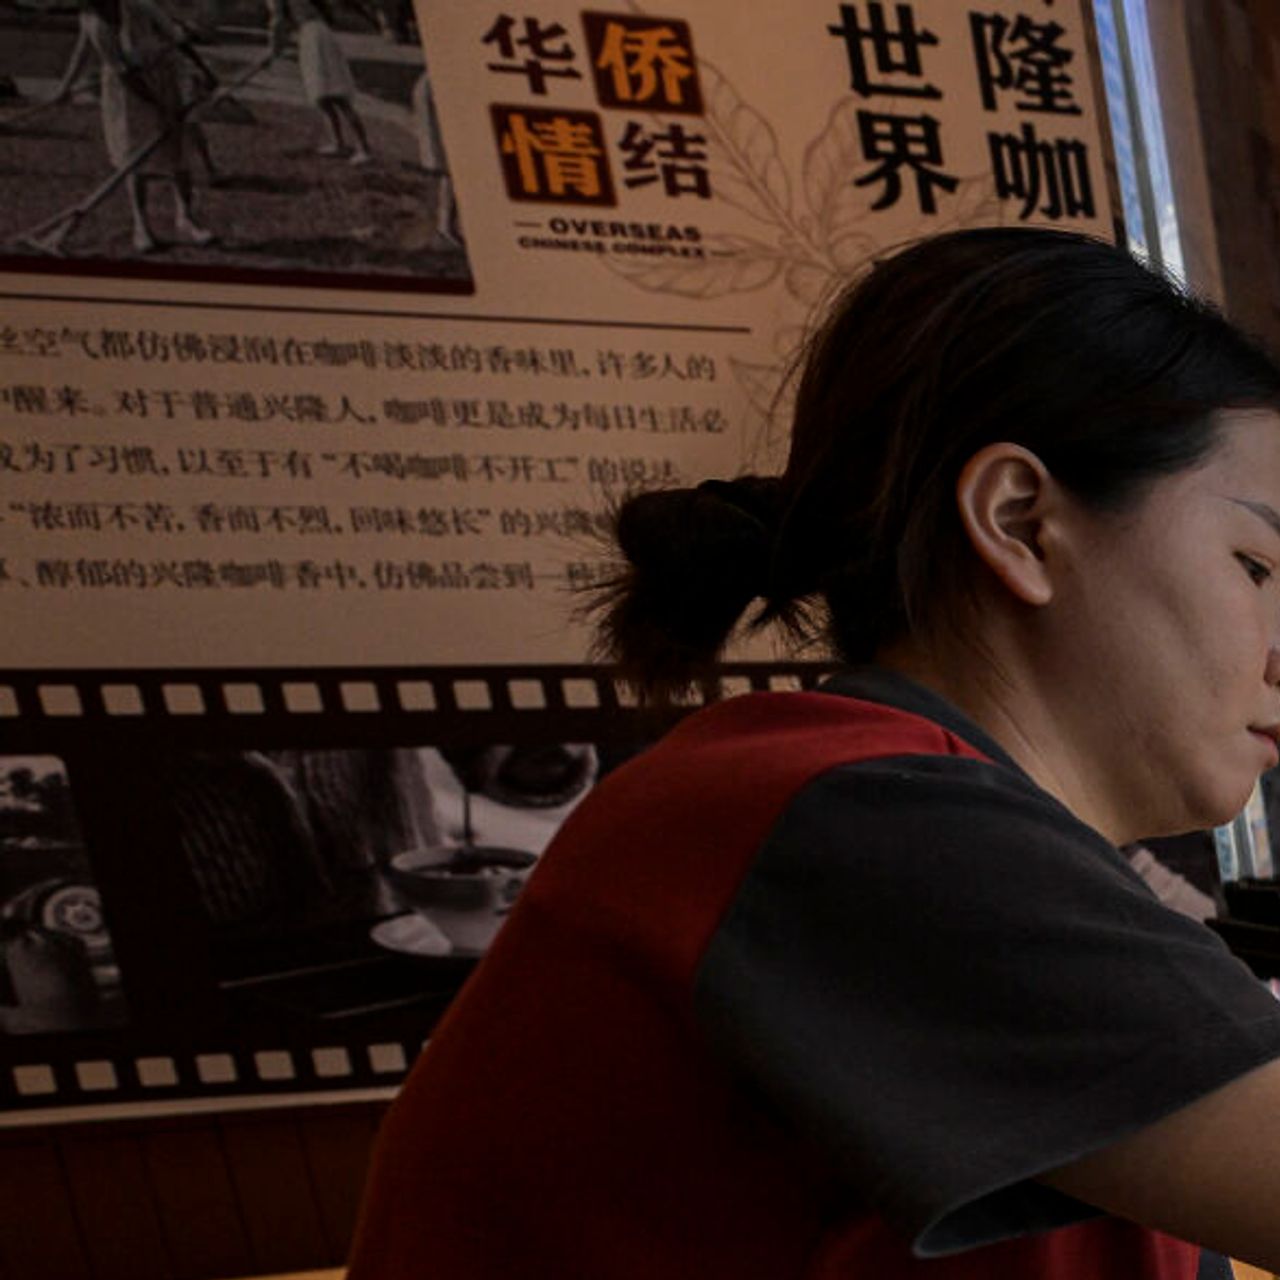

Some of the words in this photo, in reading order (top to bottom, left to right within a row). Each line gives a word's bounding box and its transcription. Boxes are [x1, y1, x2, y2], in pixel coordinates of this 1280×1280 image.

[482, 13, 694, 105] 华侨
[827, 2, 960, 214] 世界
[968, 0, 1097, 220] 隆咖
[502, 113, 713, 199] 情结
[517, 236, 604, 255] CHINESE
[611, 241, 706, 258] COMPLEX
[549, 217, 702, 242] OVERSEAS
